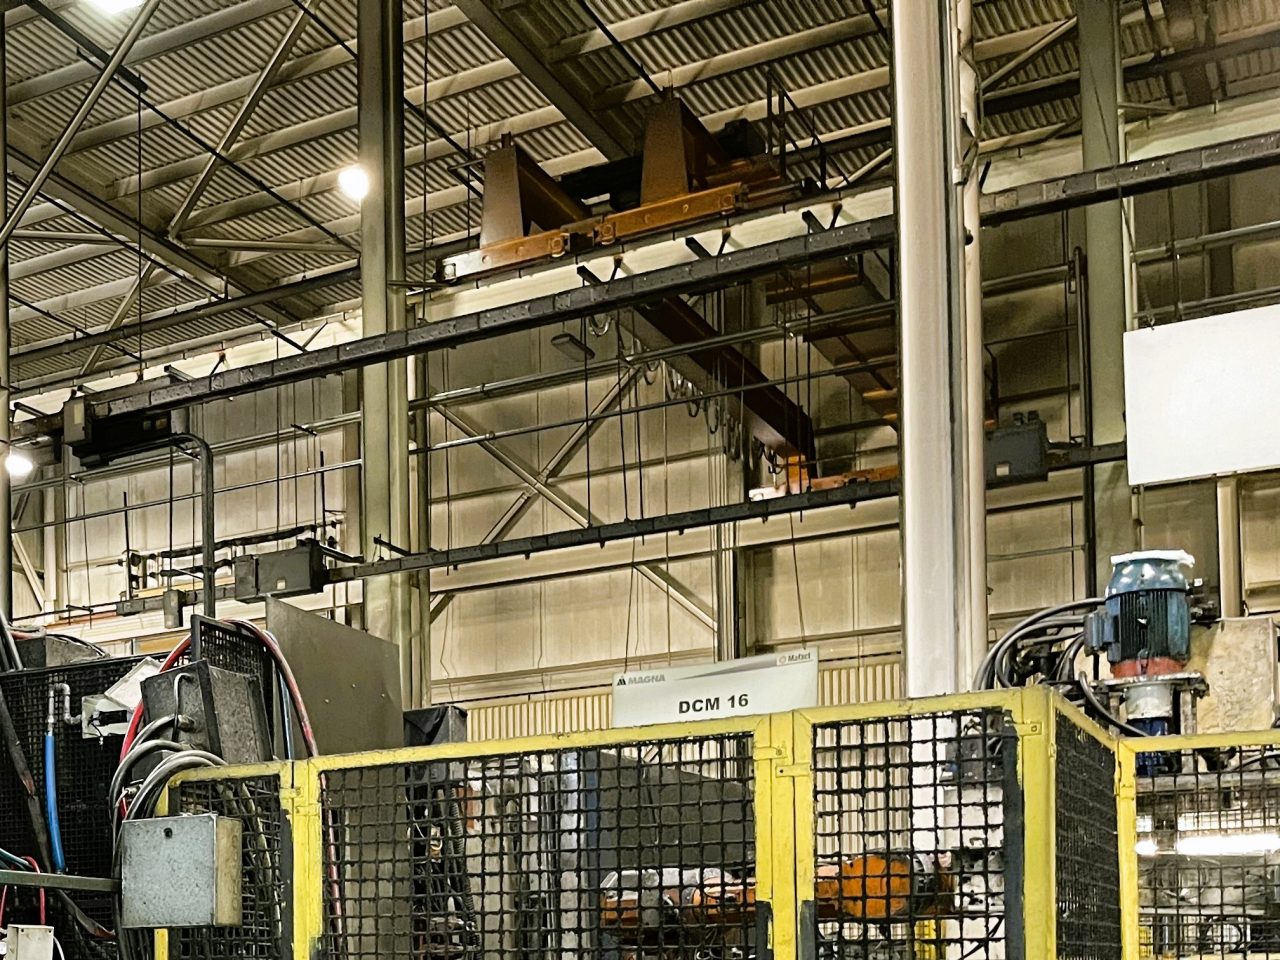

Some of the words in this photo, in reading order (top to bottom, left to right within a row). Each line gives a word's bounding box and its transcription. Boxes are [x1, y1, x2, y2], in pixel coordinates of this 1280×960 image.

[628, 674, 666, 685] MAGNA
[678, 696, 720, 714] DCM
[727, 693, 749, 709] 16
